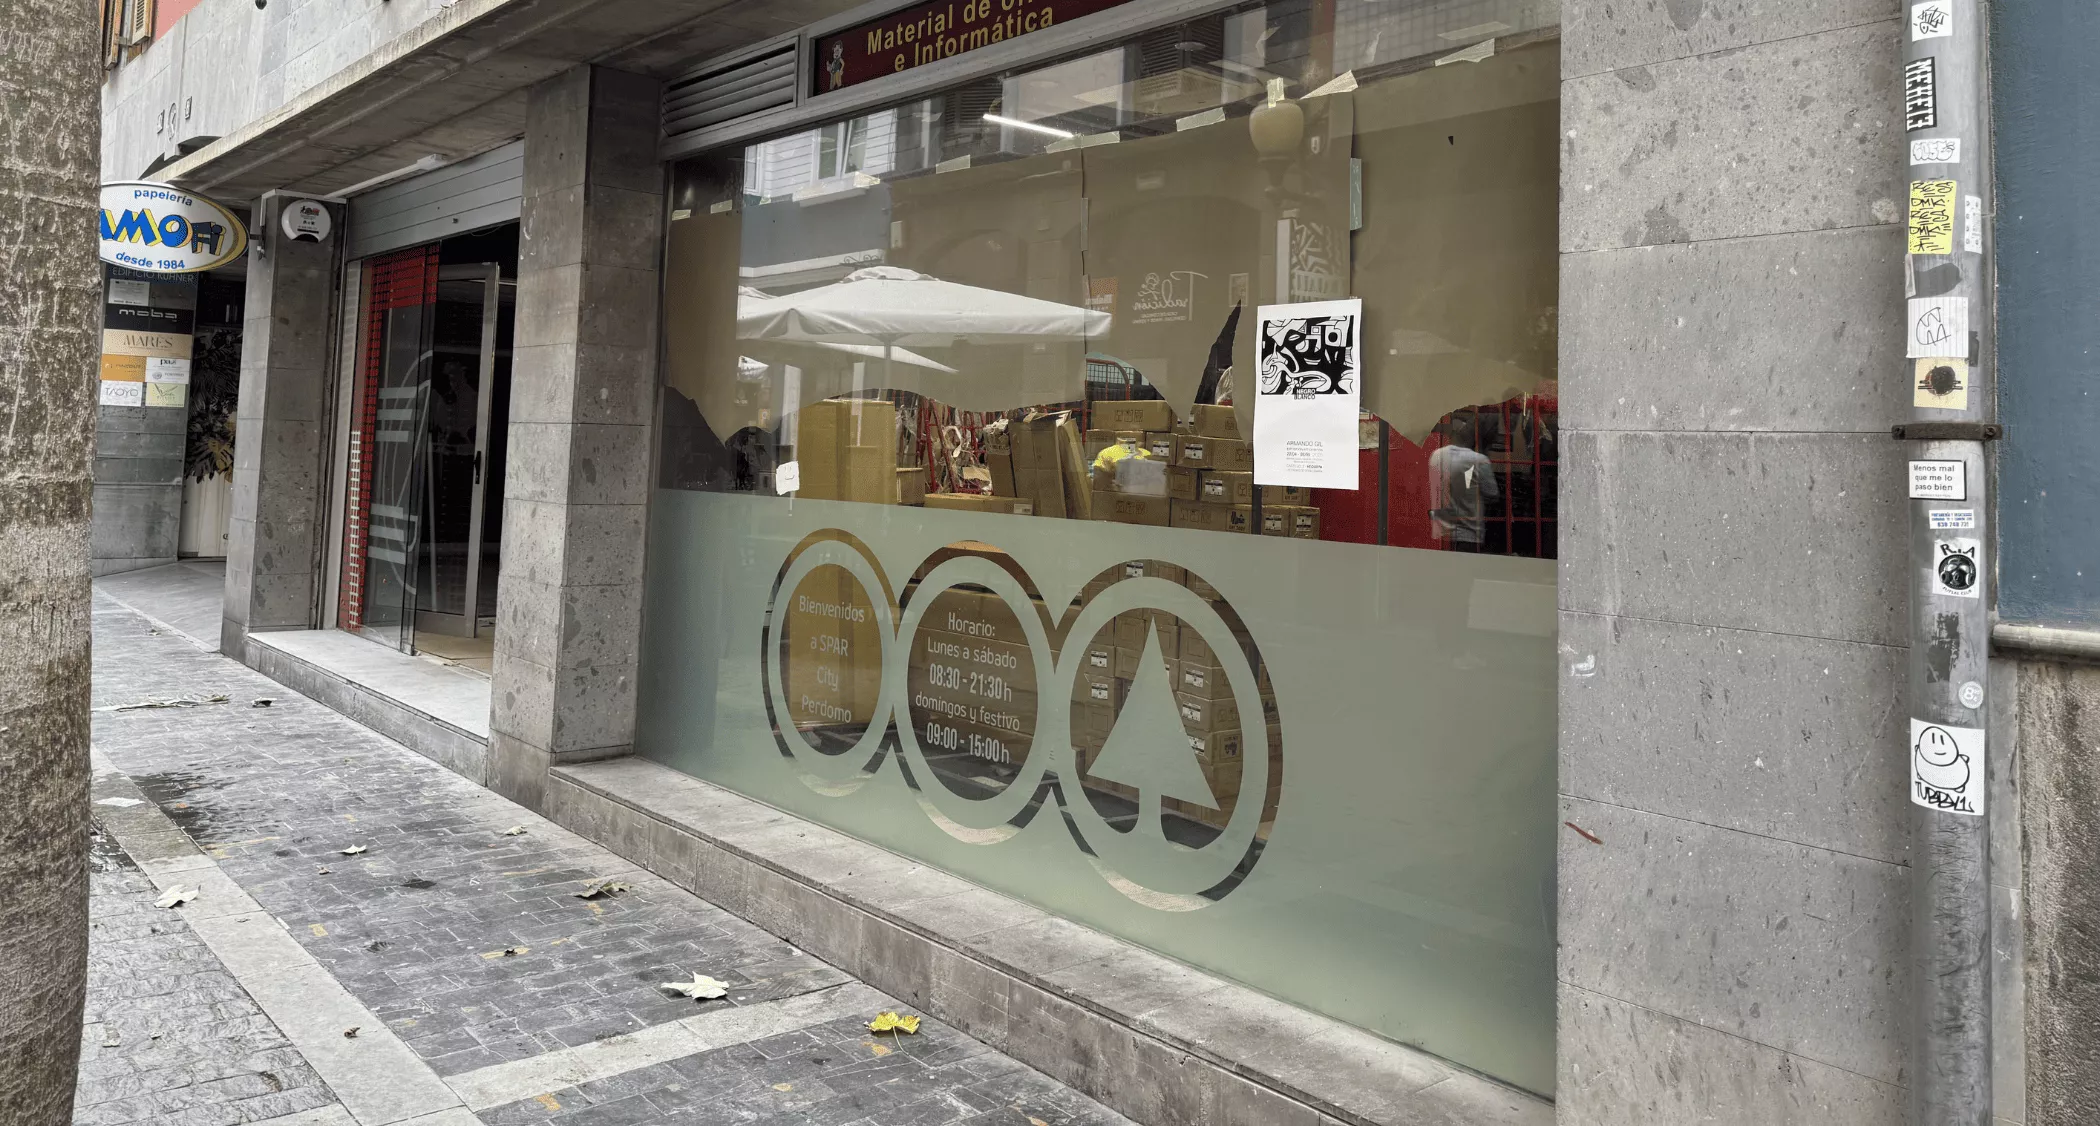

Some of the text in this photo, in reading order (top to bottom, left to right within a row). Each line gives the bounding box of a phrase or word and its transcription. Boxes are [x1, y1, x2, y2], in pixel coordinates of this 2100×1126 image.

[867, 0, 990, 55] Material de
[895, 7, 1054, 72] e Informática
[134, 189, 193, 207] papelería
[116, 252, 185, 269] desde 1984
[1913, 464, 1936, 472] Menos
[799, 595, 865, 623] Bienvenidos
[948, 612, 996, 637] Horario:
[810, 635, 849, 656] a SPAR
[927, 637, 1017, 669] Lunes a sábado
[817, 666, 839, 692] City
[930, 663, 960, 690] 08:30
[801, 694, 852, 723] Perdomo
[915, 691, 1020, 732] domingos y festivo
[927, 722, 957, 750] 09:00
